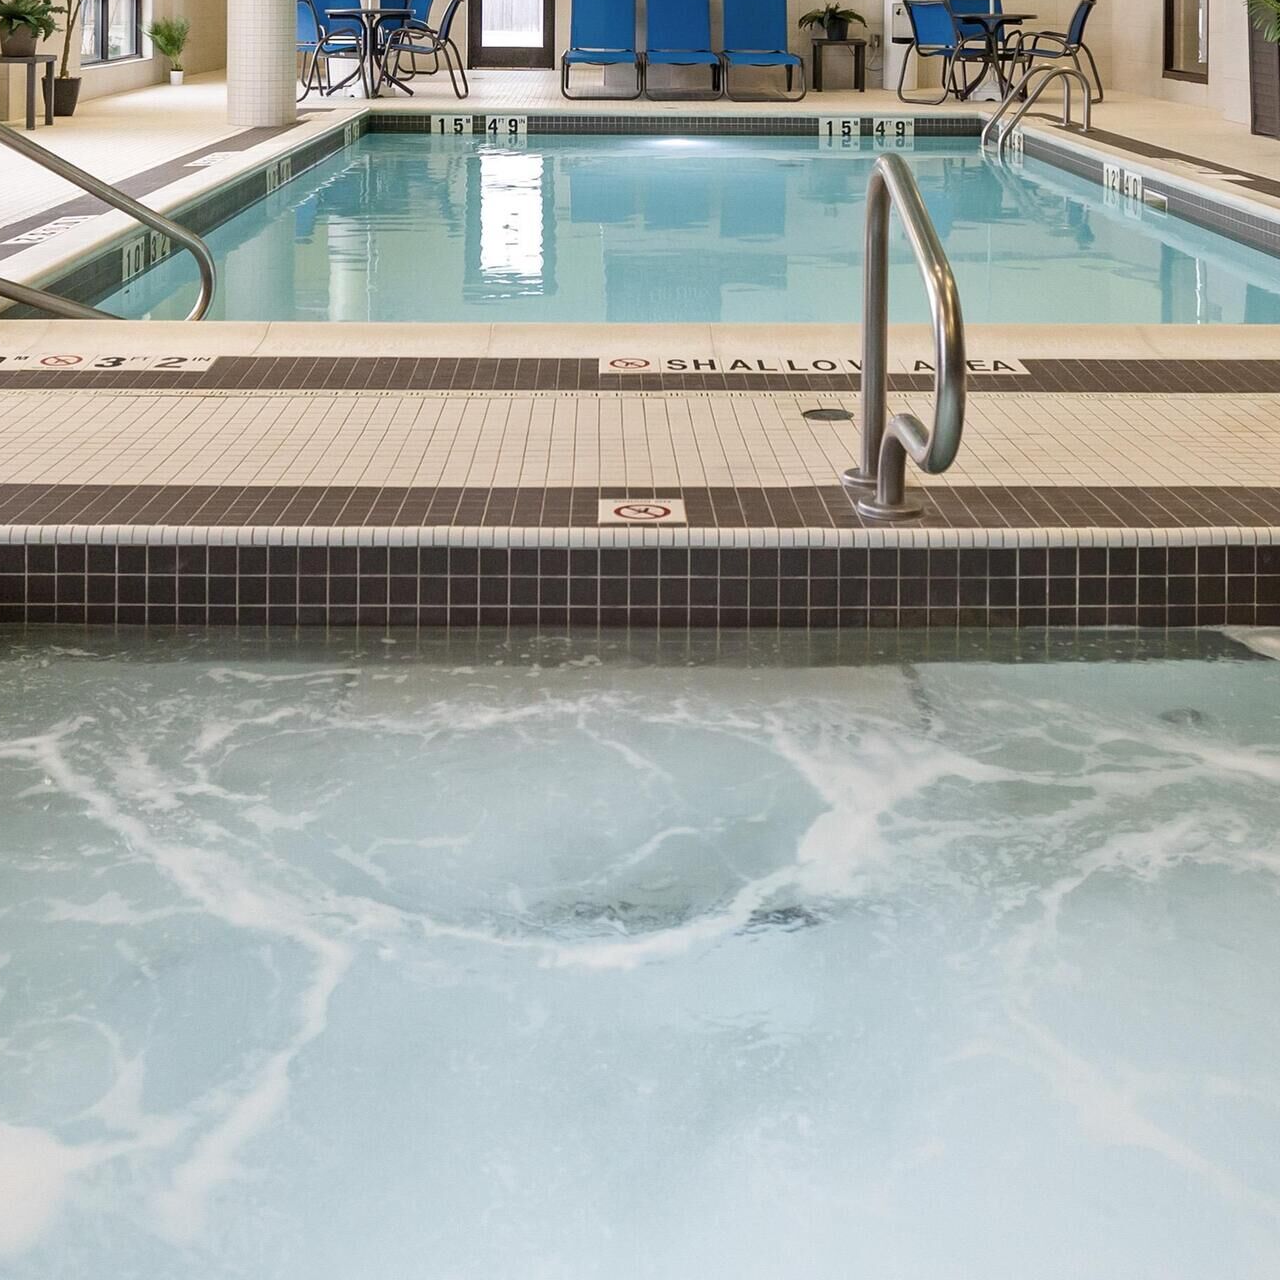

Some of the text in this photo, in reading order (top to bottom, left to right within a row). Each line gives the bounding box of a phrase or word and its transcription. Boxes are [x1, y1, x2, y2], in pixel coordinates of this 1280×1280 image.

[488, 118, 498, 136] 4
[508, 118, 518, 135] 9
[875, 120, 885, 137] 4
[895, 120, 905, 137] 9
[94, 357, 126, 368] 3
[154, 357, 188, 368] 2
[913, 360, 1017, 372] AEA
